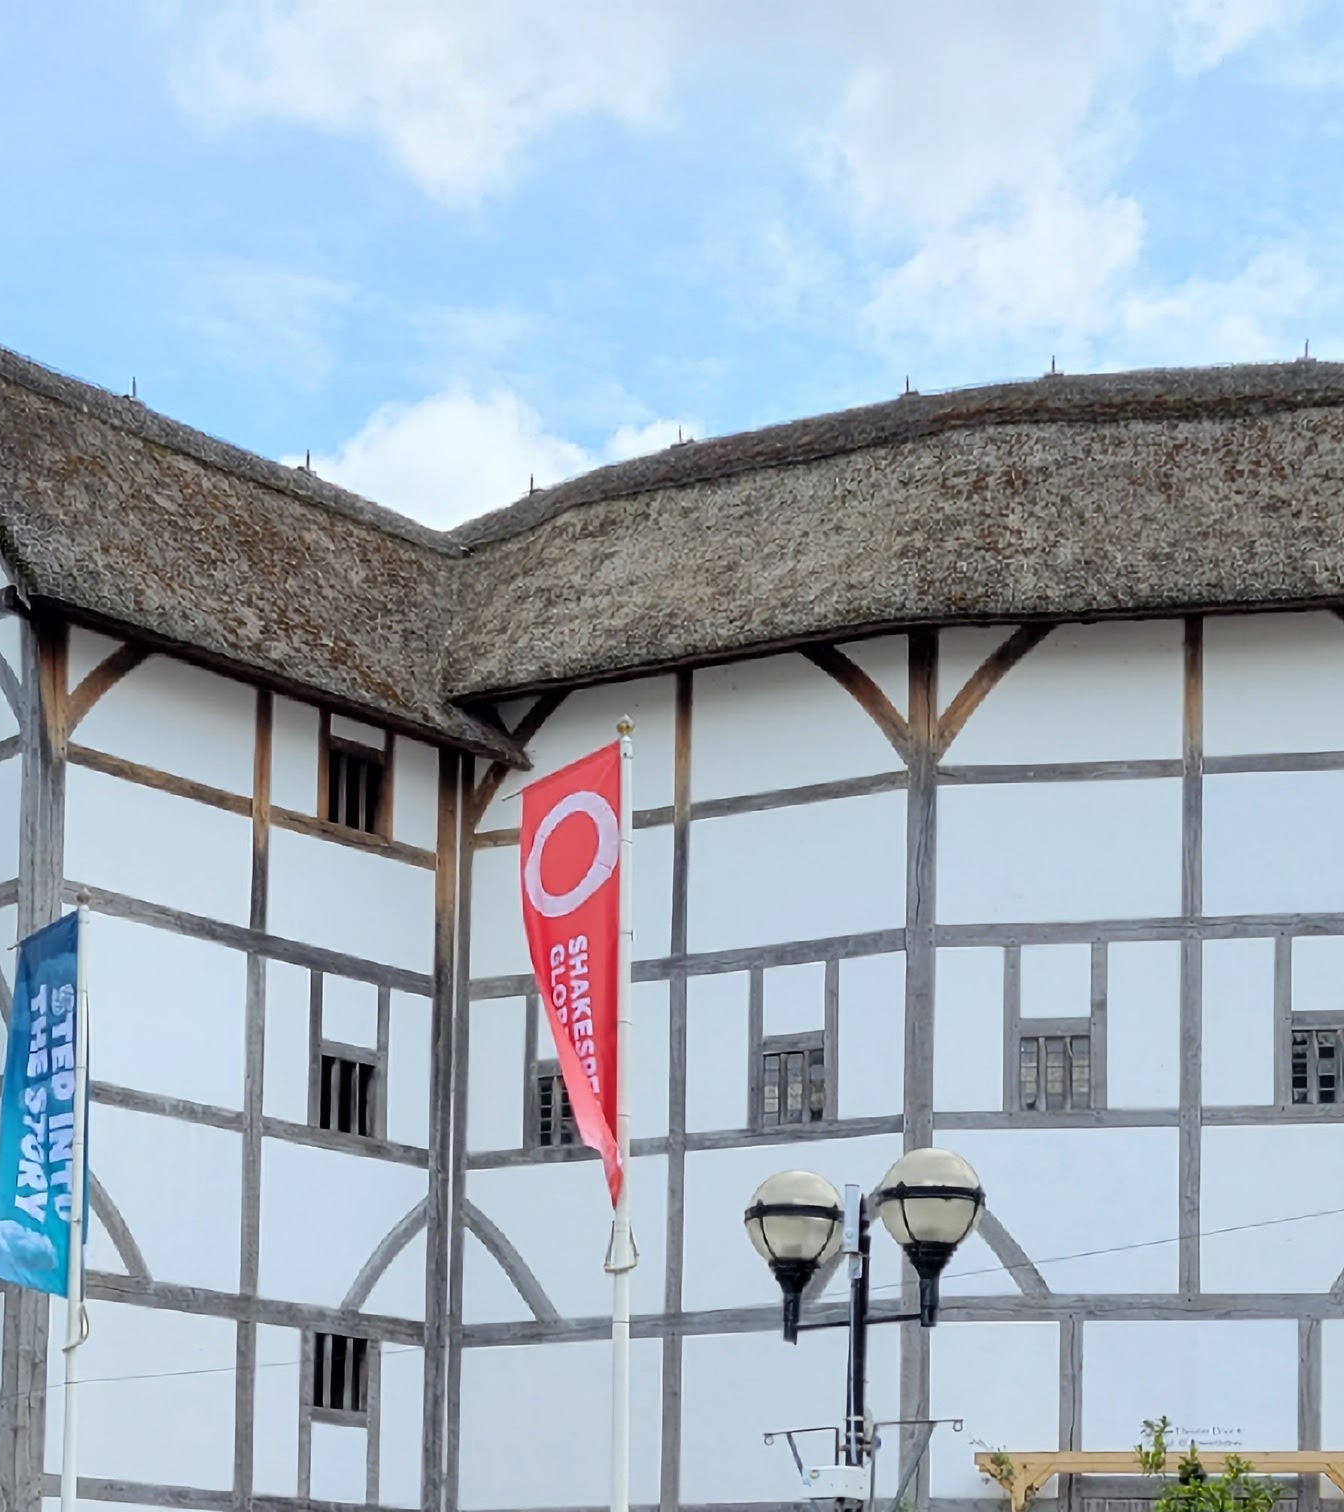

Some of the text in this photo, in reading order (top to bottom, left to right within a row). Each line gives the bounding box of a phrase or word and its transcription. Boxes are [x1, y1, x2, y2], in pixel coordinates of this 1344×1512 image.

[14, 984, 48, 1223] THE STORY
[48, 983, 75, 1223] STEP INTO
[567, 935, 601, 1095] SHAKESPE
